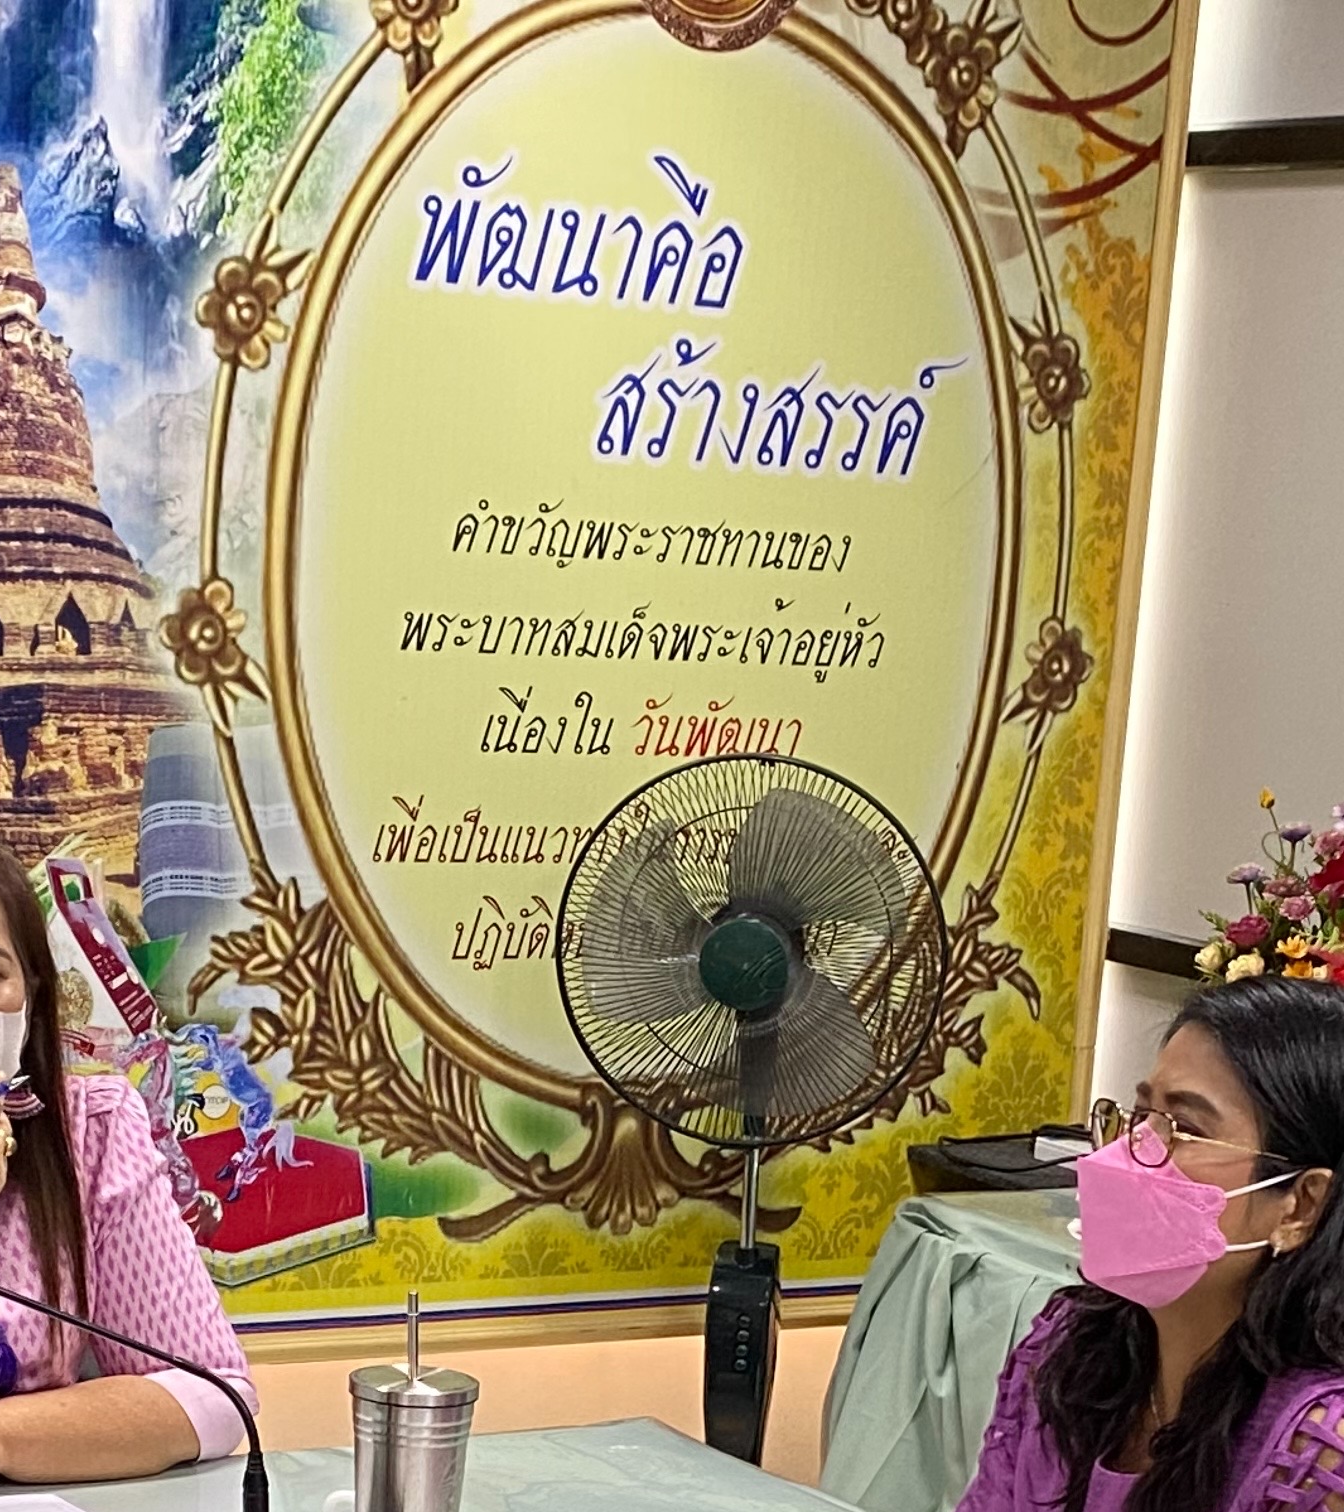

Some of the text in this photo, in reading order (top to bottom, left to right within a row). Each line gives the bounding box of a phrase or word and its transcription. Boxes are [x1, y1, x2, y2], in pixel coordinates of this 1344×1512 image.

[413, 154, 744, 310] พัฒนาคือ
[596, 337, 969, 477] สร้างสรรค์
[451, 498, 853, 574] คำขวัญพระราชทานของ
[399, 598, 886, 684] พระบาทสมเด็จพระเจ้าอยู่หัว
[479, 685, 615, 756] เนื่องใน
